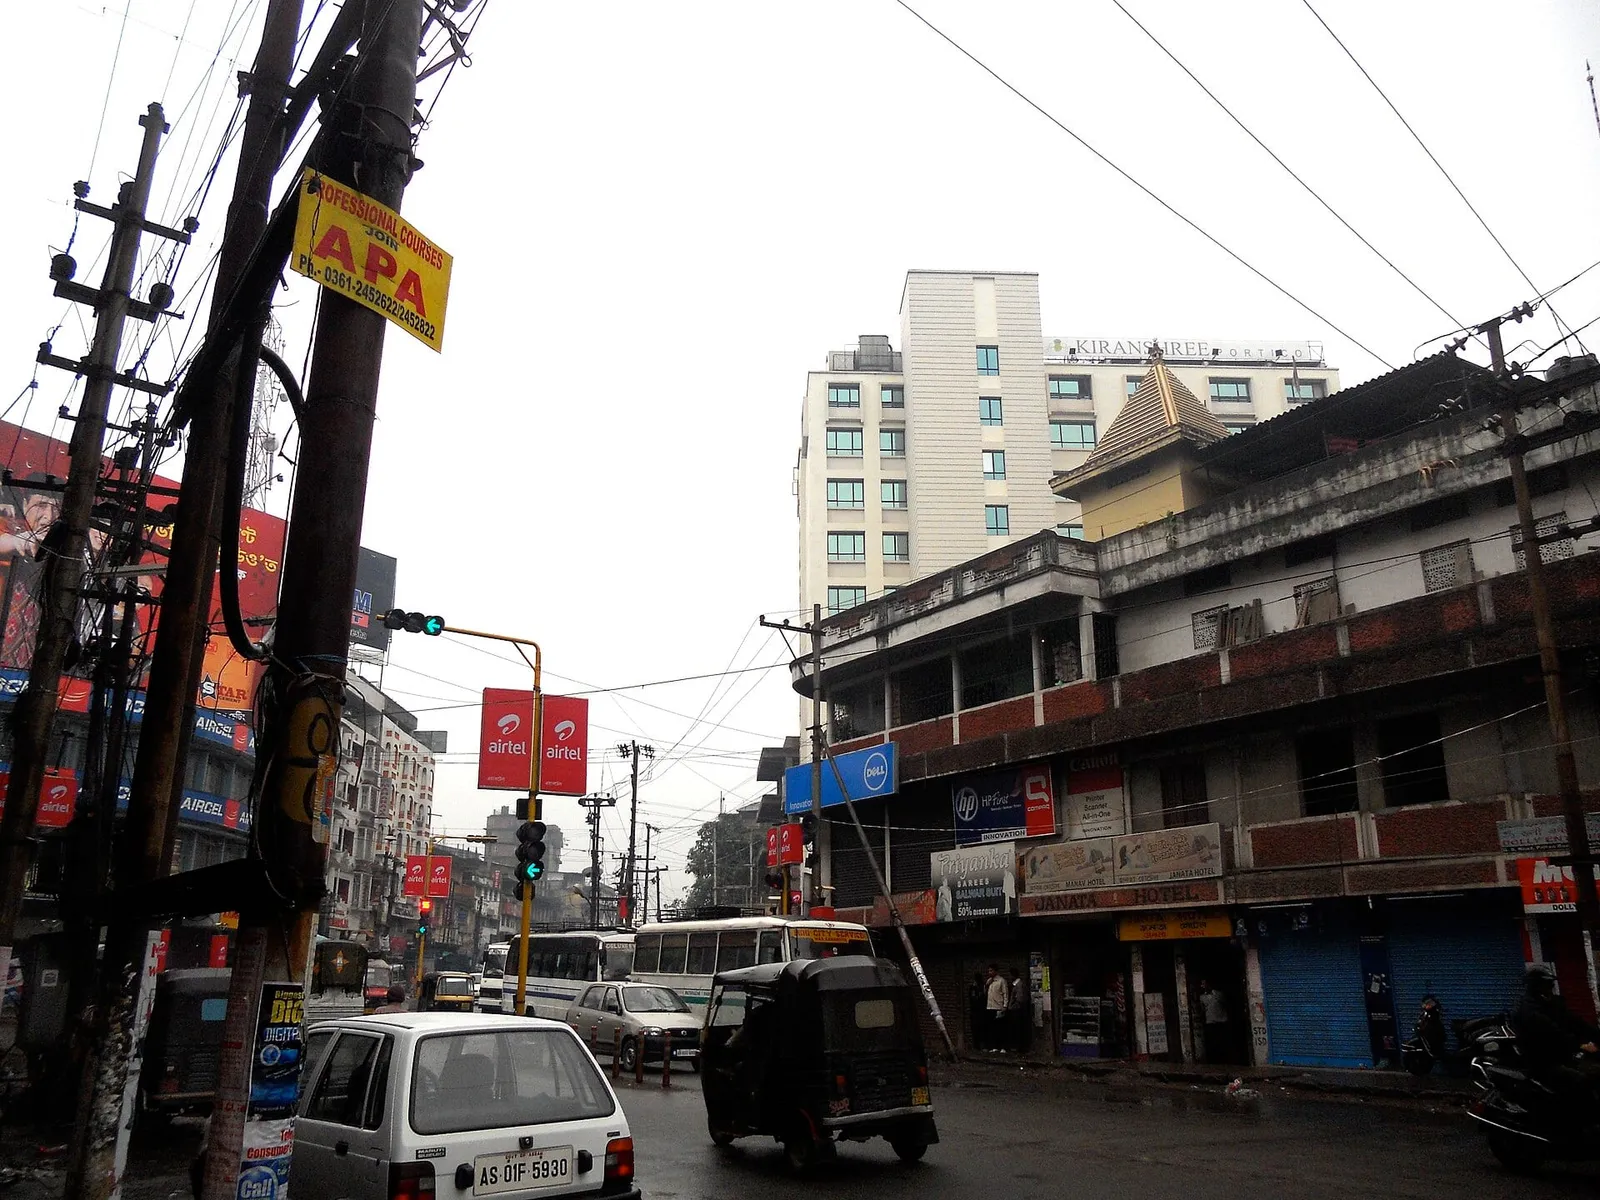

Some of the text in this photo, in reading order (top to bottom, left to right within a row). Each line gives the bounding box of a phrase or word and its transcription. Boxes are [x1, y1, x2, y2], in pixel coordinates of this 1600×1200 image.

[314, 180, 443, 271] ROFESSIONAL COURSES
[364, 228, 399, 252] JOIN
[313, 225, 427, 318] APA
[489, 739, 527, 755] airtel
[546, 745, 582, 761] airtel
[867, 765, 885, 778] DELL
[41, 800, 69, 813] airtel
[180, 797, 224, 818] AIRCEL
[983, 830, 1025, 840] INNOVATION
[937, 847, 1010, 879] Priyanka
[1194, 867, 1215, 876] HOTEL
[240, 1177, 273, 1199] Call
